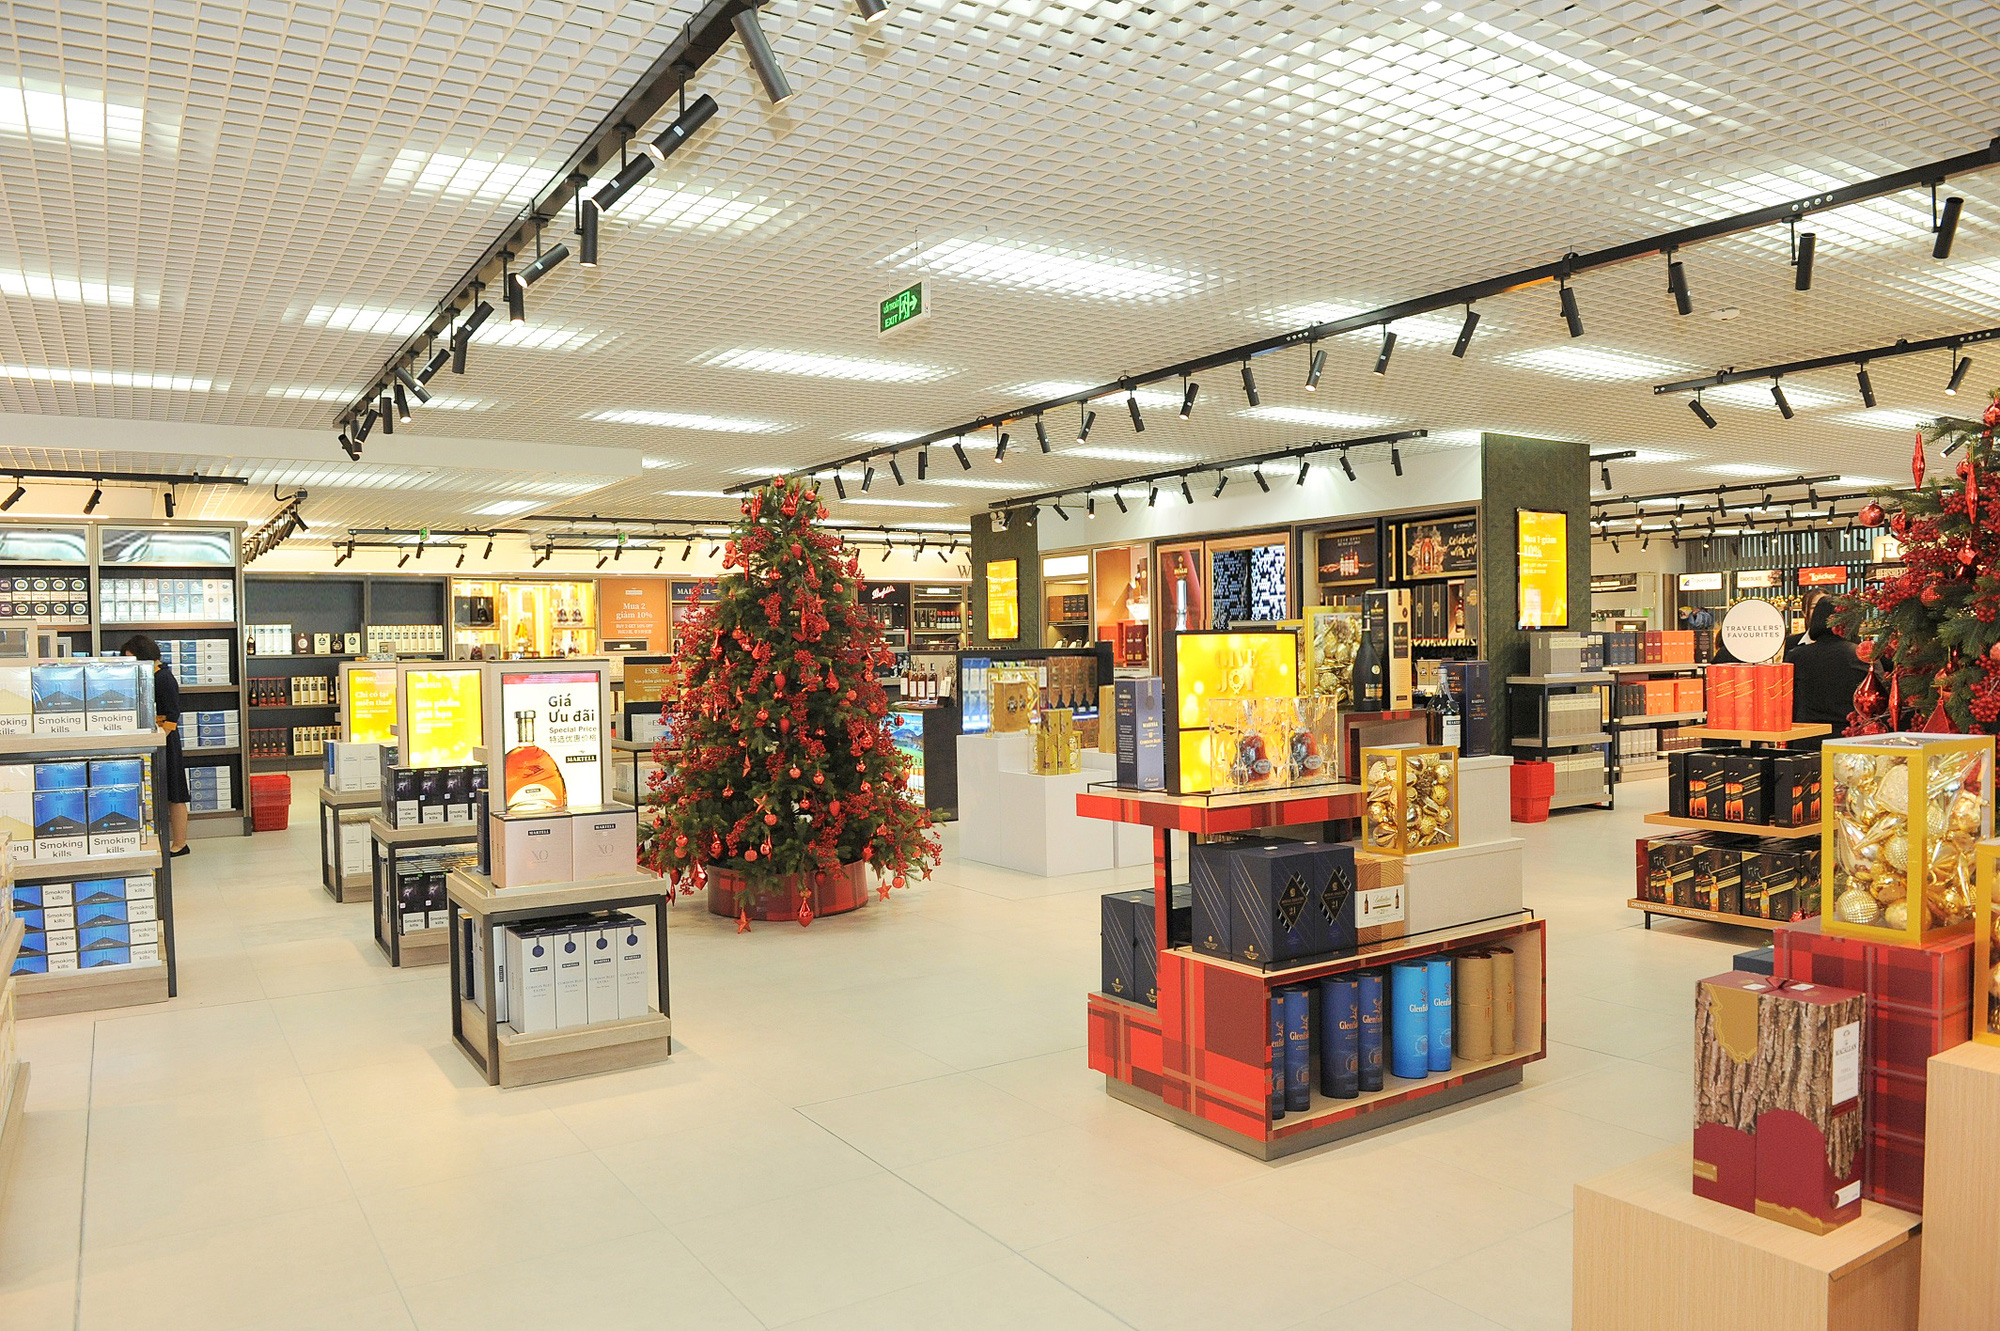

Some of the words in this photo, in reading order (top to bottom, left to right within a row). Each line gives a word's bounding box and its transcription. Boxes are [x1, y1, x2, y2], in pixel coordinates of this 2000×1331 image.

[885, 314, 898, 328] EXIT
[1214, 650, 1258, 668] GIVE
[548, 693, 572, 707] Giá
[91, 714, 133, 723] Smoking
[549, 709, 568, 722] Ưu
[573, 709, 595, 722] đãi
[38, 716, 81, 725] Smoking
[40, 840, 83, 849] Smoking
[94, 836, 136, 845] Smoking
[52, 849, 72, 858] kills
[106, 845, 125, 854] kills
